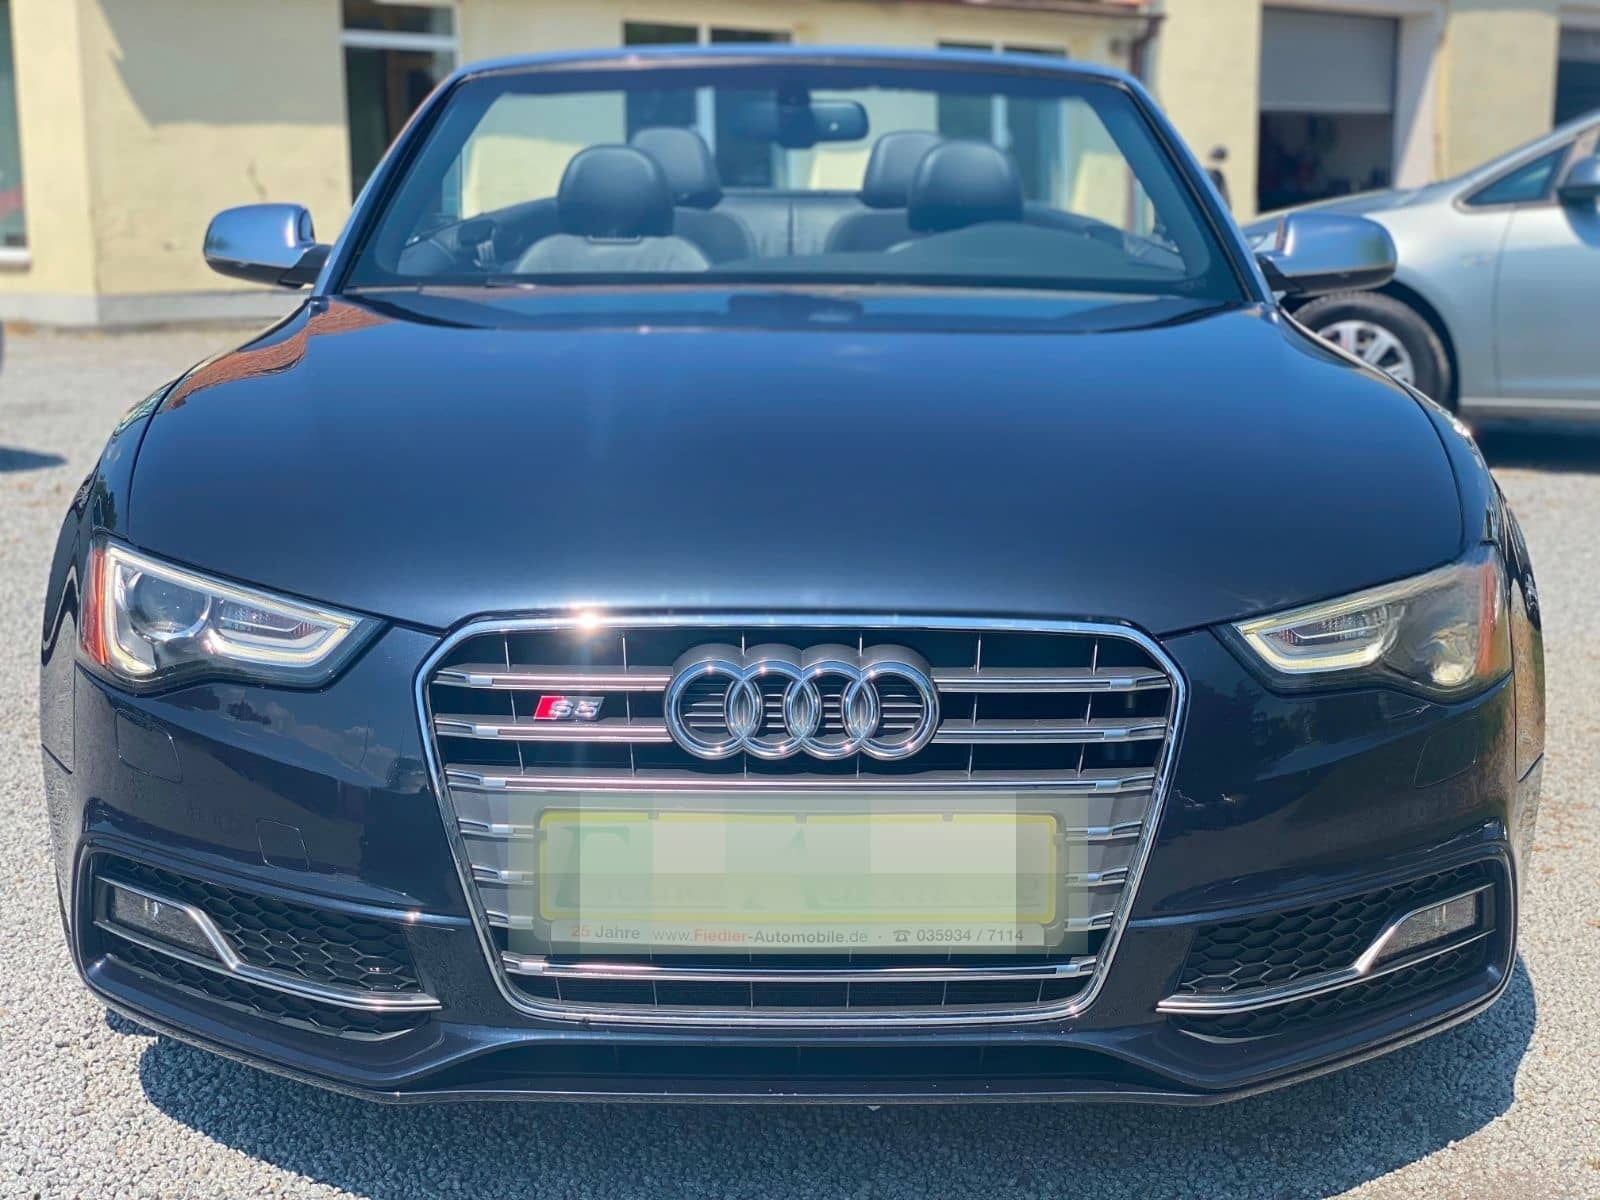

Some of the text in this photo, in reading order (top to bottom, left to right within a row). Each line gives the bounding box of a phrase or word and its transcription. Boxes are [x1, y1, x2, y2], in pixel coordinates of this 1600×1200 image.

[546, 699, 601, 718] S5
[571, 926, 1025, 944] 25 Jahre www.Fiedler-Automobile.de 035934 / 7114
